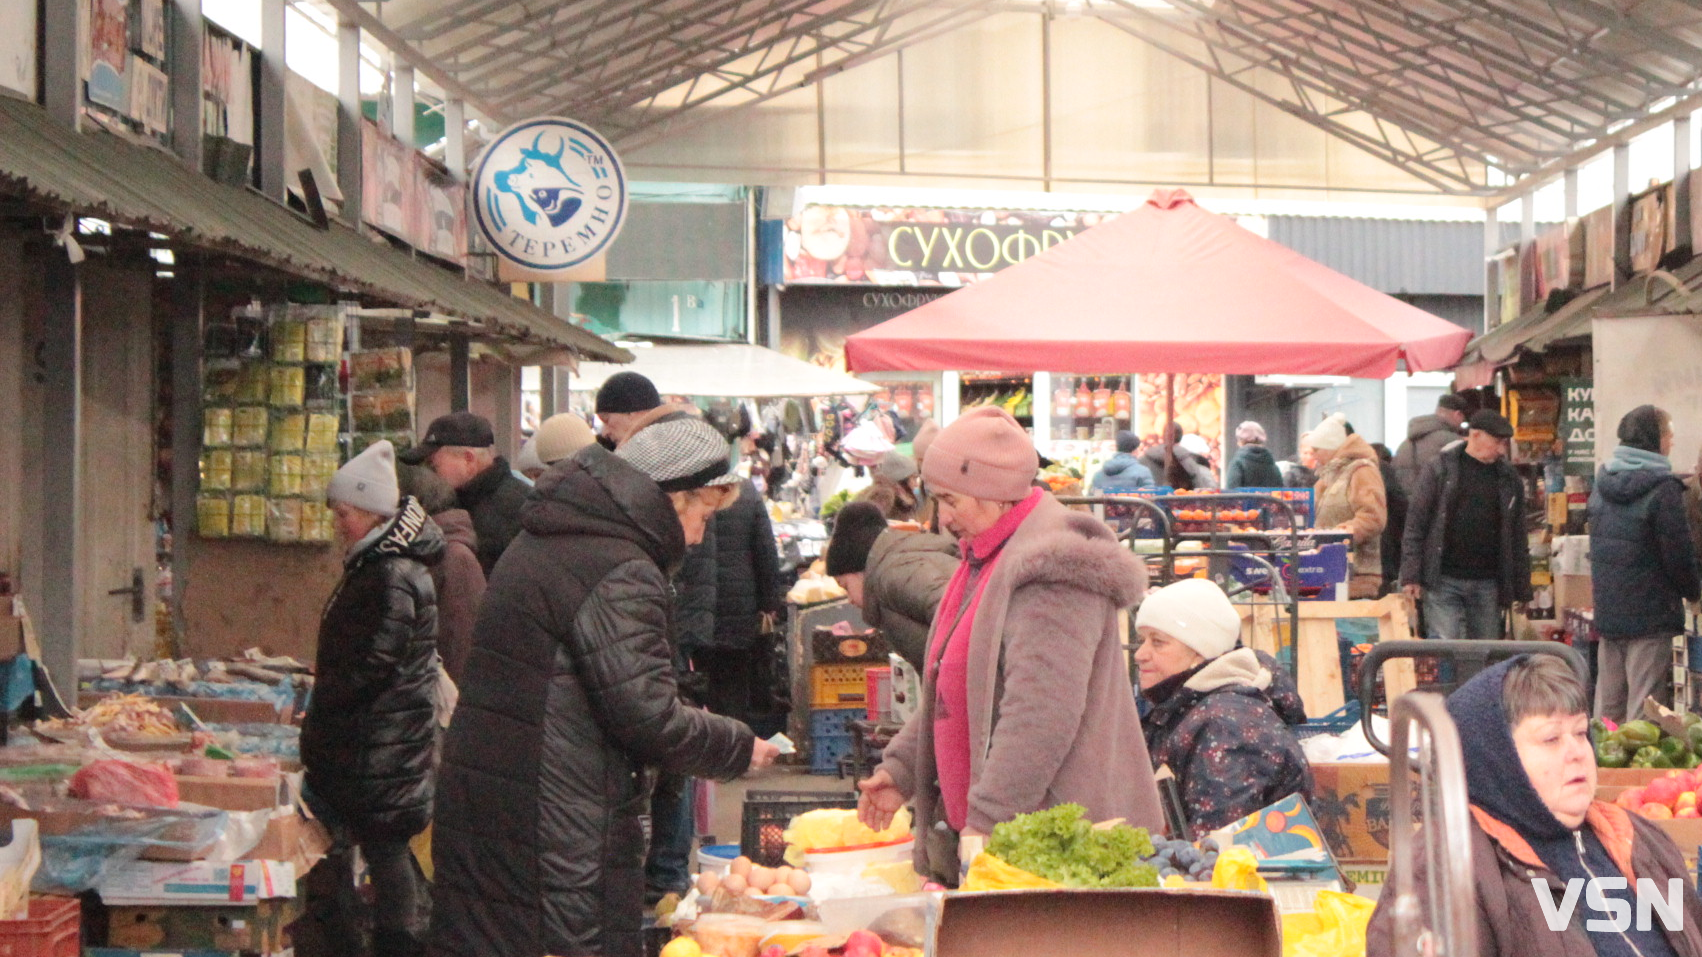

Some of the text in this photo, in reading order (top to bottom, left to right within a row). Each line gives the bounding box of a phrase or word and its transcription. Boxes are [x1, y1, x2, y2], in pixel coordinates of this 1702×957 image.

[587, 155, 604, 165] TM
[508, 185, 613, 258] ТЕРЕМНО
[888, 226, 1076, 270] СУХОФР
[671, 294, 681, 332] 1
[1246, 566, 1280, 575] swet
